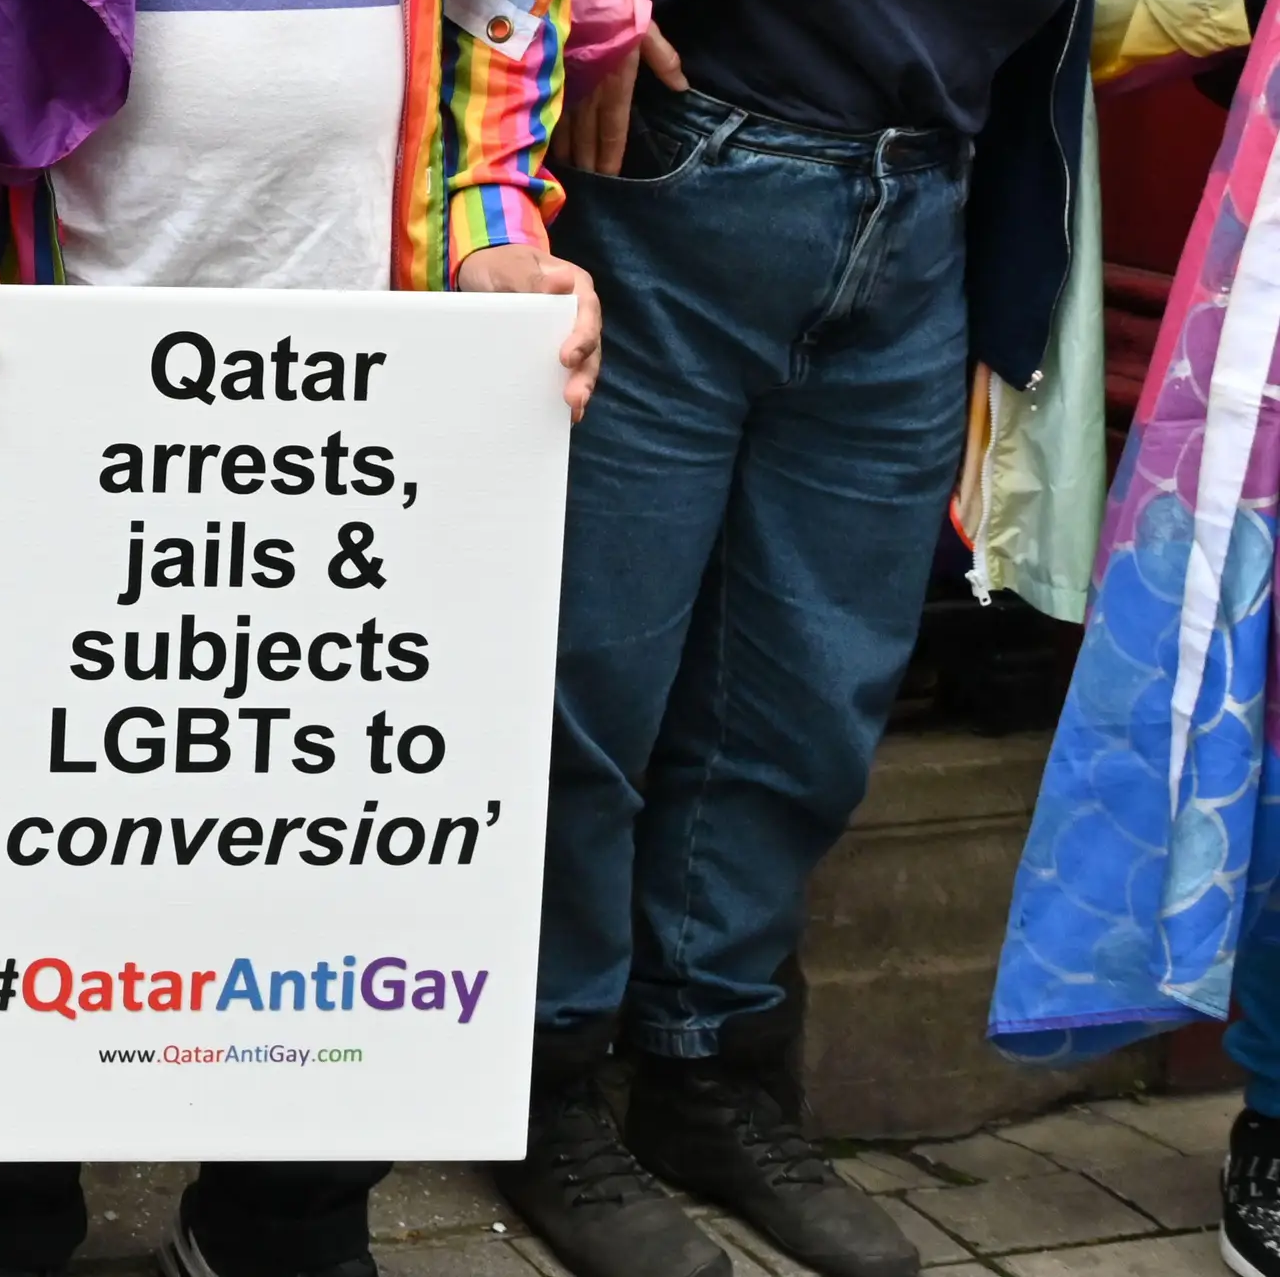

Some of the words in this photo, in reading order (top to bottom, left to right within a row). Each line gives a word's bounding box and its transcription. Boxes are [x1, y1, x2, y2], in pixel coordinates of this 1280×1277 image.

[150, 330, 388, 406] Qatar
[99, 430, 418, 510] arrests,
[116, 520, 296, 606] jails
[327, 521, 388, 590] &
[69, 614, 430, 700] subjects
[49, 706, 336, 775] LGBTs
[365, 709, 446, 775] to
[97, 1043, 364, 1068] www.QatarAntiGay.com
